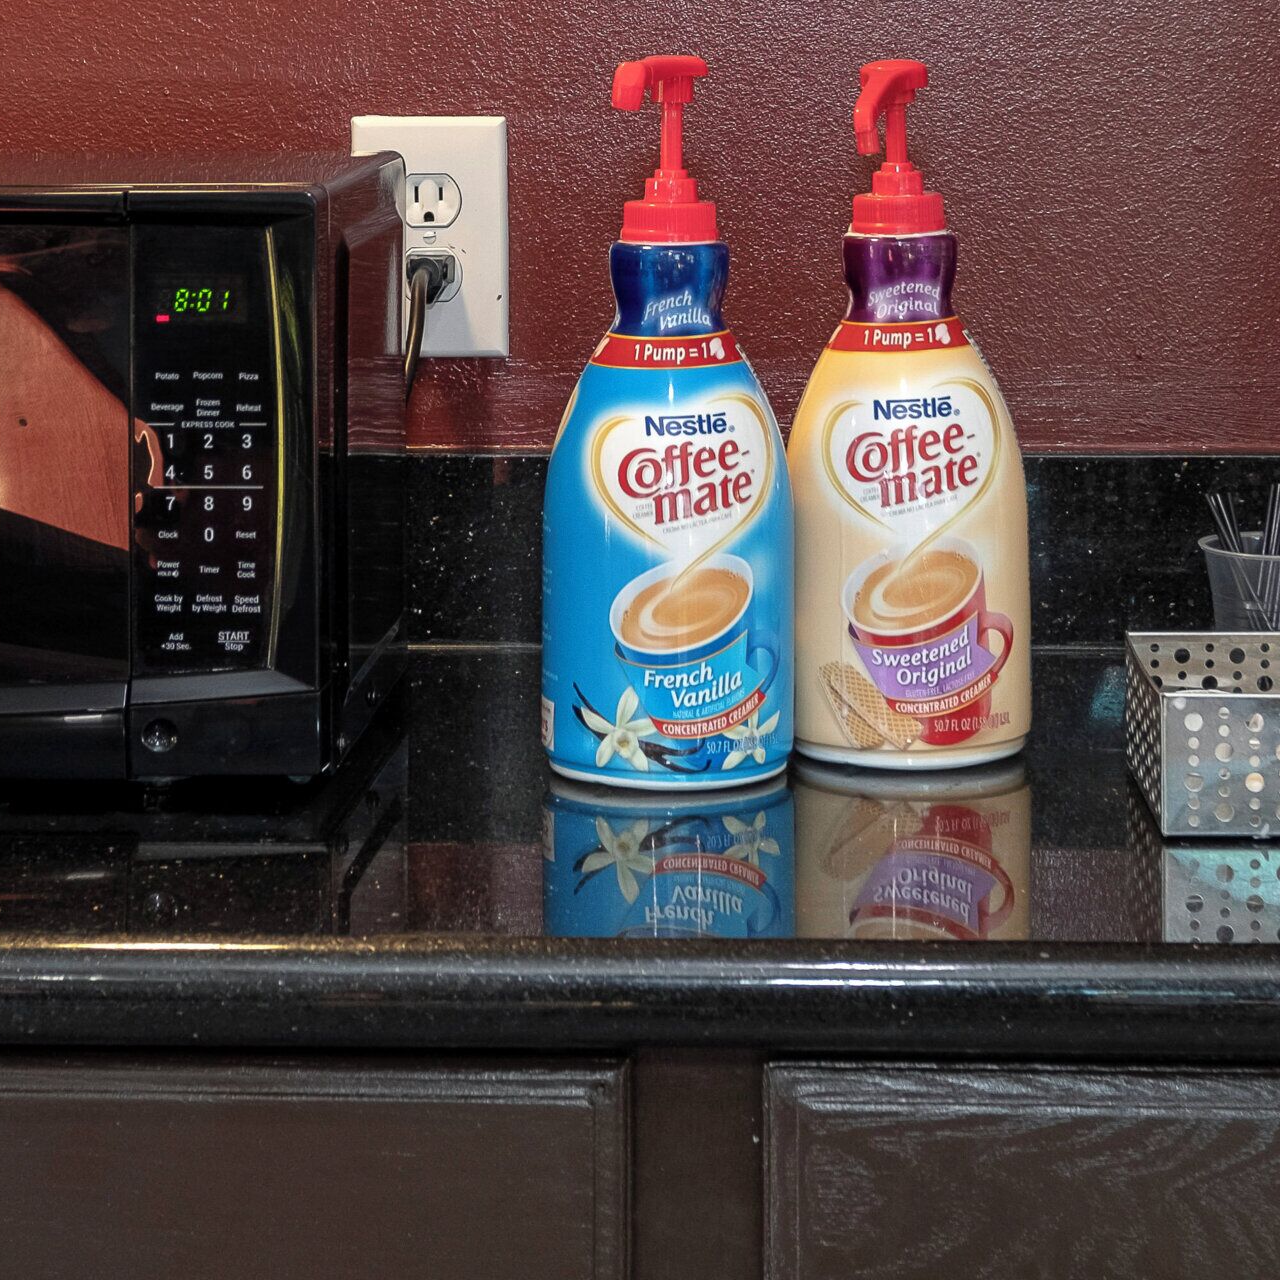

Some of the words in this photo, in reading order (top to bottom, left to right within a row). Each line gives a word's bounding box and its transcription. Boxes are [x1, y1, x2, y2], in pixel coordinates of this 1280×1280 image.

[174, 288, 230, 312] 8:01
[868, 280, 940, 307] Sweetened
[642, 289, 693, 324] French
[876, 299, 939, 319] Original
[863, 329, 869, 345] 1
[873, 330, 912, 349] Pump
[927, 327, 933, 343] 1
[634, 344, 640, 361] 1
[644, 345, 686, 365] Pump
[701, 342, 708, 358] 1
[155, 371, 180, 380] Potato
[193, 371, 223, 381] Popcorn
[239, 372, 259, 380] Pizza
[150, 403, 184, 412] Beverage
[236, 404, 261, 412] Reheat
[196, 398, 221, 407] Frozen
[196, 409, 220, 417] Dinner
[181, 421, 213, 429] EXPRESS
[167, 433, 174, 449] 1
[203, 433, 214, 449] 2
[242, 433, 252, 449] 3
[165, 464, 176, 480] 4
[204, 464, 214, 480] 5
[242, 464, 252, 480] 6
[879, 454, 978, 509] mate
[165, 496, 176, 511] 7
[204, 496, 214, 511] 8
[242, 496, 252, 511] 9
[652, 470, 753, 525] mate
[158, 530, 178, 539] Clock
[204, 527, 214, 542] 0
[236, 530, 256, 539] Reset
[157, 561, 180, 569] Power
[238, 561, 256, 569] Time
[199, 565, 220, 574] Timer
[237, 570, 256, 579] Cook
[174, 595, 183, 604] by
[196, 594, 223, 602] Defrost
[234, 595, 260, 605] Speed
[156, 604, 181, 614] Weight
[192, 604, 201, 613] by
[202, 604, 227, 614] Weight
[232, 604, 261, 613] Defrost
[169, 632, 184, 641] Add
[218, 631, 250, 640] START
[176, 642, 192, 650] Sec.
[224, 643, 244, 651] Stop
[871, 625, 970, 668] Sweetened
[643, 661, 714, 689] French
[896, 650, 972, 688] Original
[670, 671, 743, 709] Vanilla
[895, 697, 960, 714] CONCENTRATED
[960, 673, 992, 703] CREAMER
[662, 718, 727, 735] CONCENTRATED
[728, 692, 759, 724] CREAMER
[672, 710, 695, 719] NATURAL
[934, 719, 950, 732] 50.7
[951, 720, 960, 732] FL
[961, 718, 971, 730] OZ
[706, 740, 722, 754] 50.7
[723, 740, 731, 753] FL
